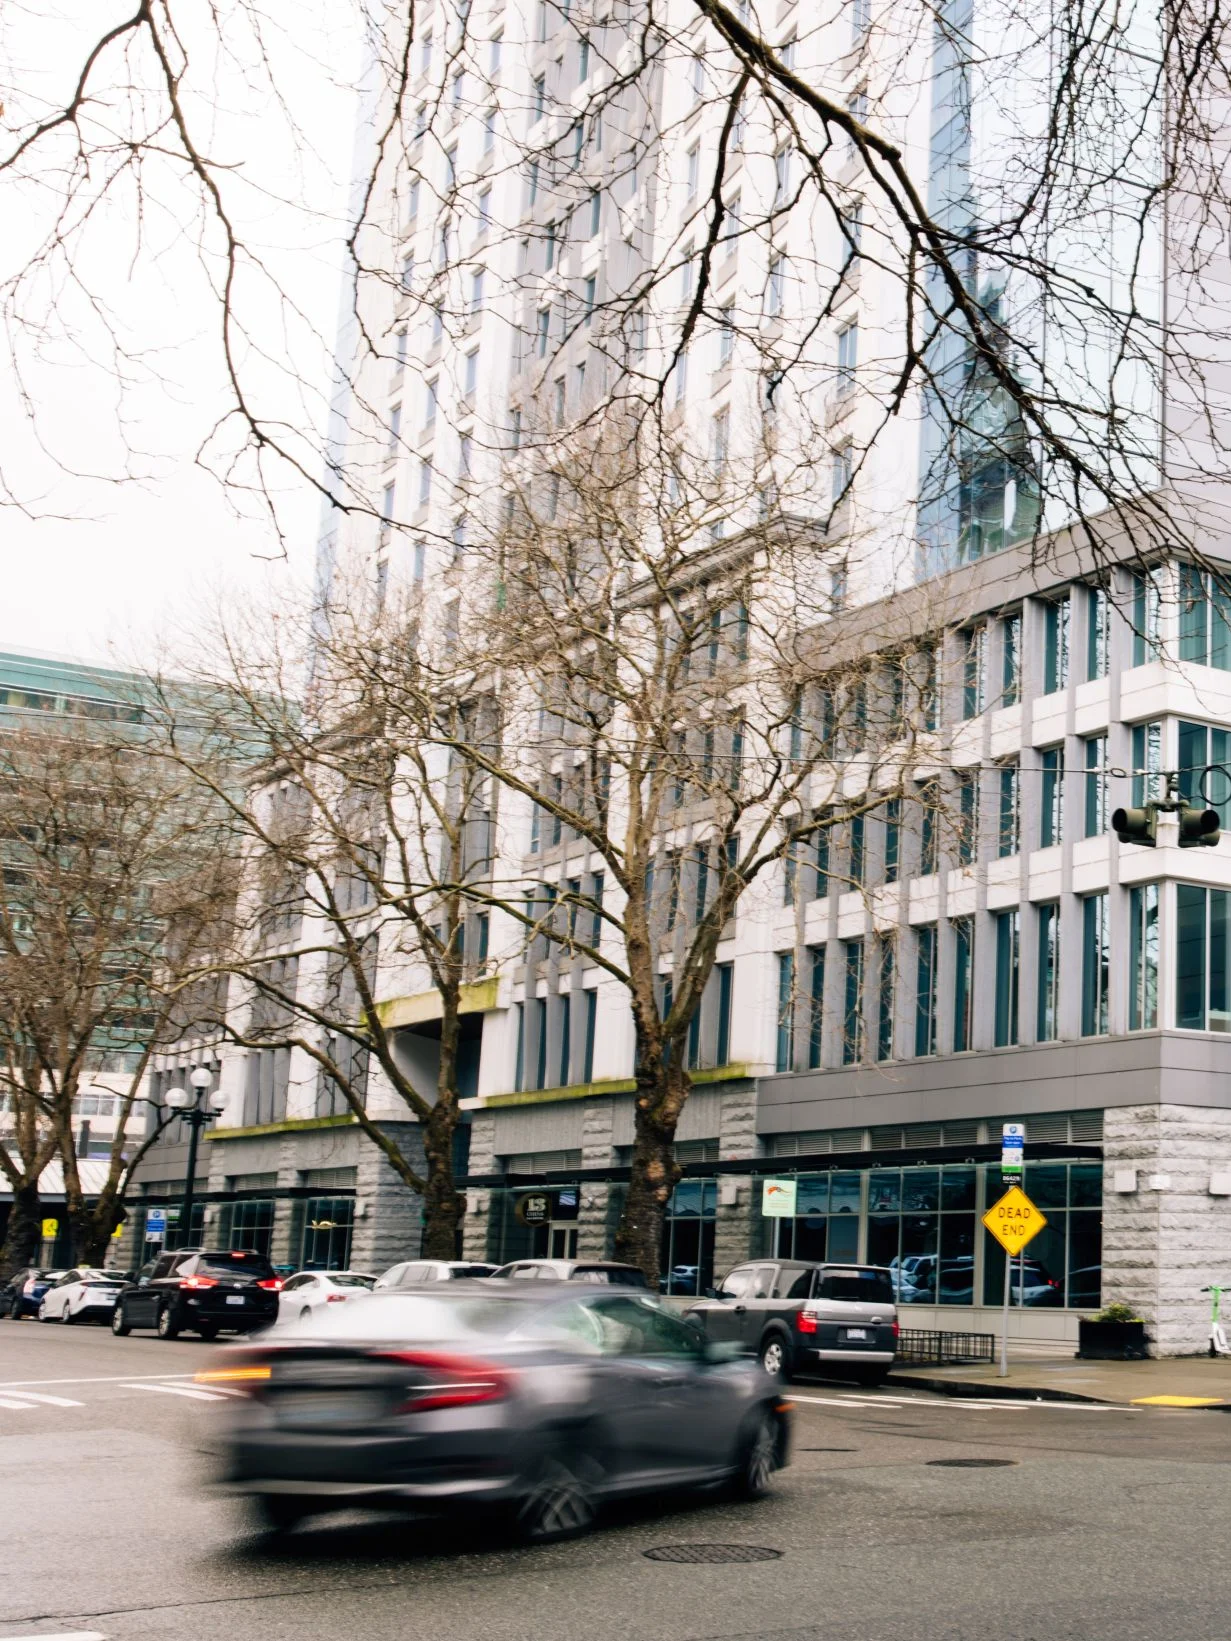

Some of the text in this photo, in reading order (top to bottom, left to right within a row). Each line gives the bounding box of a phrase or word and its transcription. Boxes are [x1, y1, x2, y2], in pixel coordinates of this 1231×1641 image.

[527, 1198, 546, 1211] 13
[998, 1207, 1030, 1219] DEAD
[1002, 1224, 1025, 1236] END
